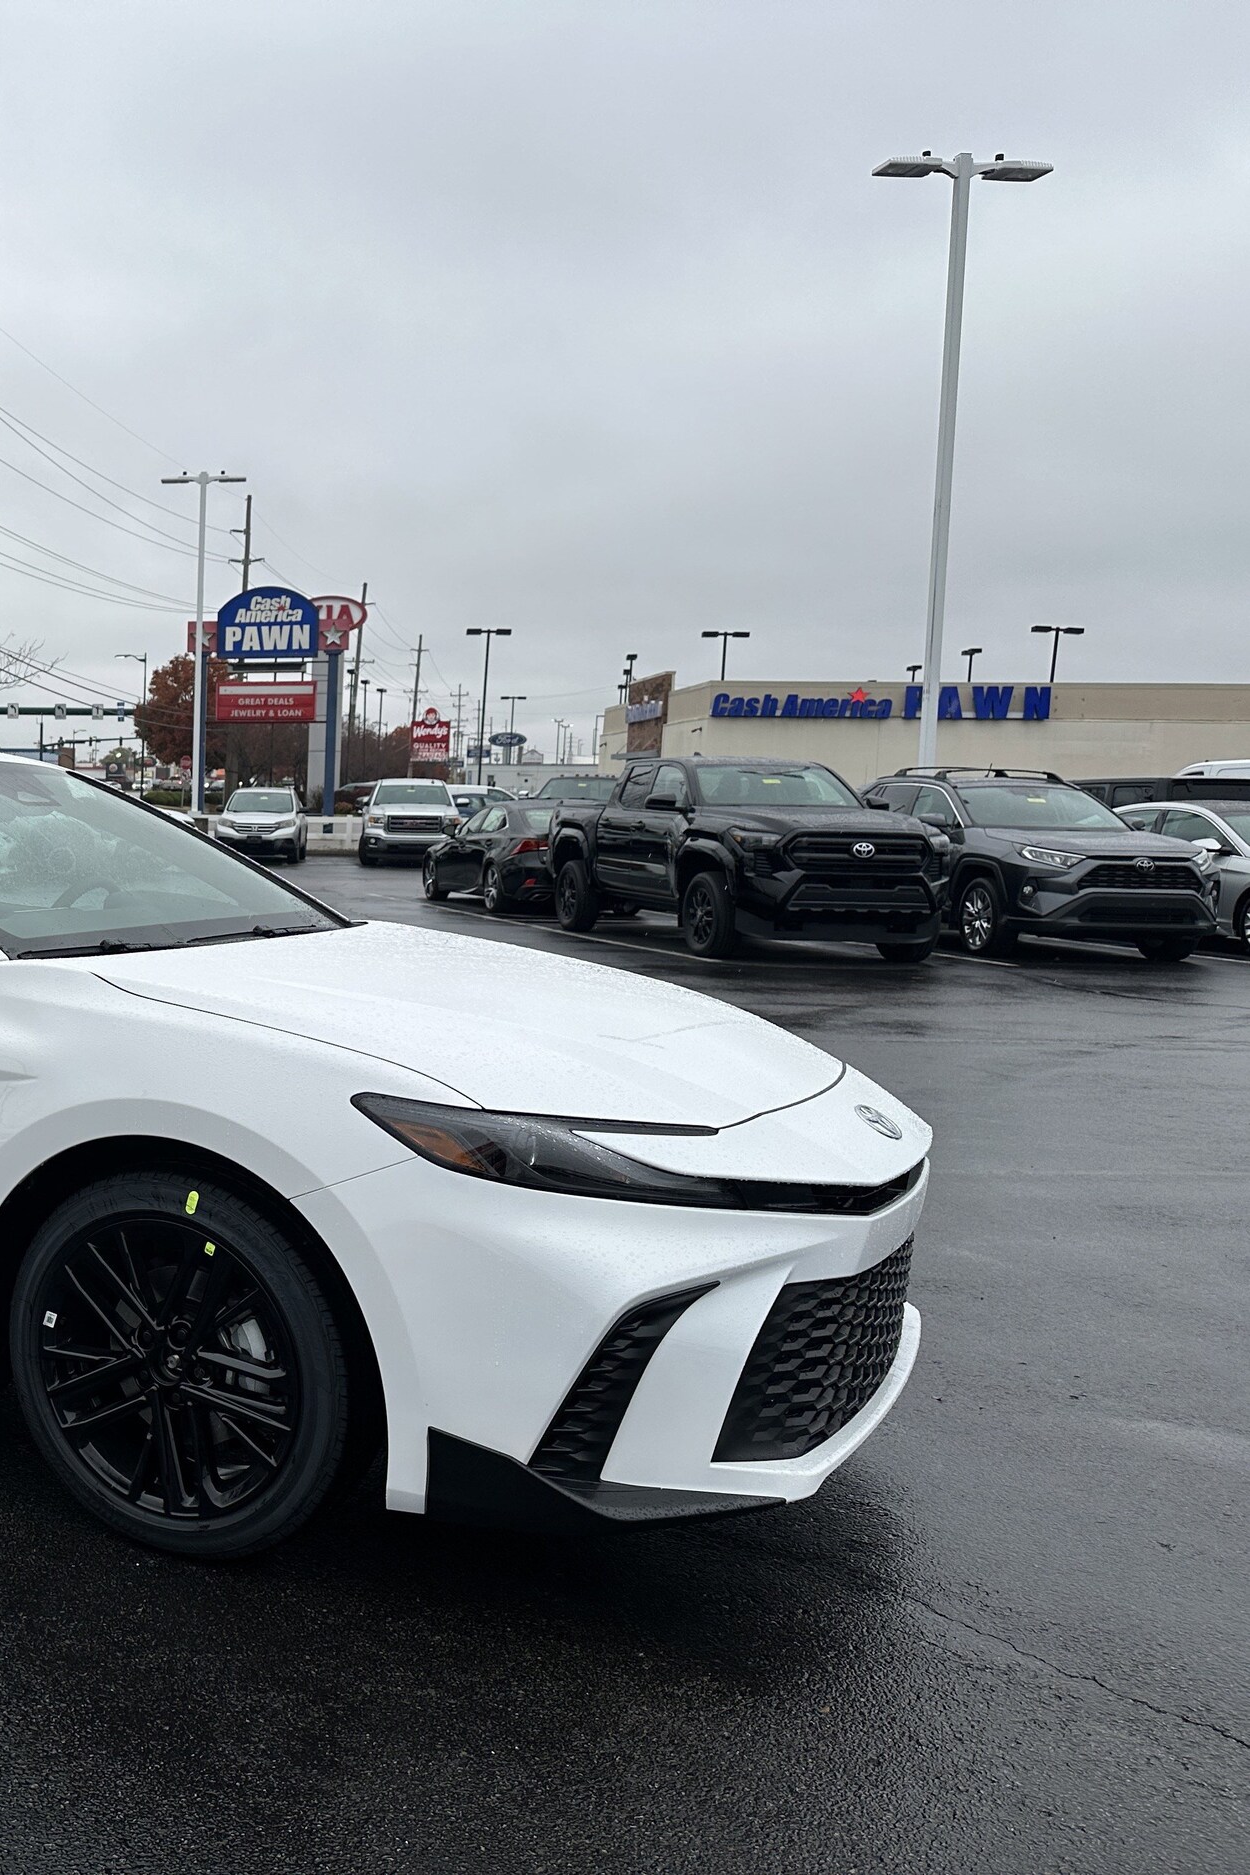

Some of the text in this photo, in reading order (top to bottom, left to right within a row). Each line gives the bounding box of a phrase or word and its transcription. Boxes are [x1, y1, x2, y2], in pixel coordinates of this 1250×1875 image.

[250, 595, 291, 611] Cash
[234, 608, 303, 623] America
[317, 604, 354, 625] IA
[225, 624, 310, 651] PAWN
[267, 697, 294, 705] DEALS
[711, 686, 1052, 720] Cash America PAWN
[230, 709, 266, 717] JEWELRY
[277, 709, 302, 717] LOAN
[412, 723, 448, 738] Wendy's
[495, 735, 519, 744] Ford
